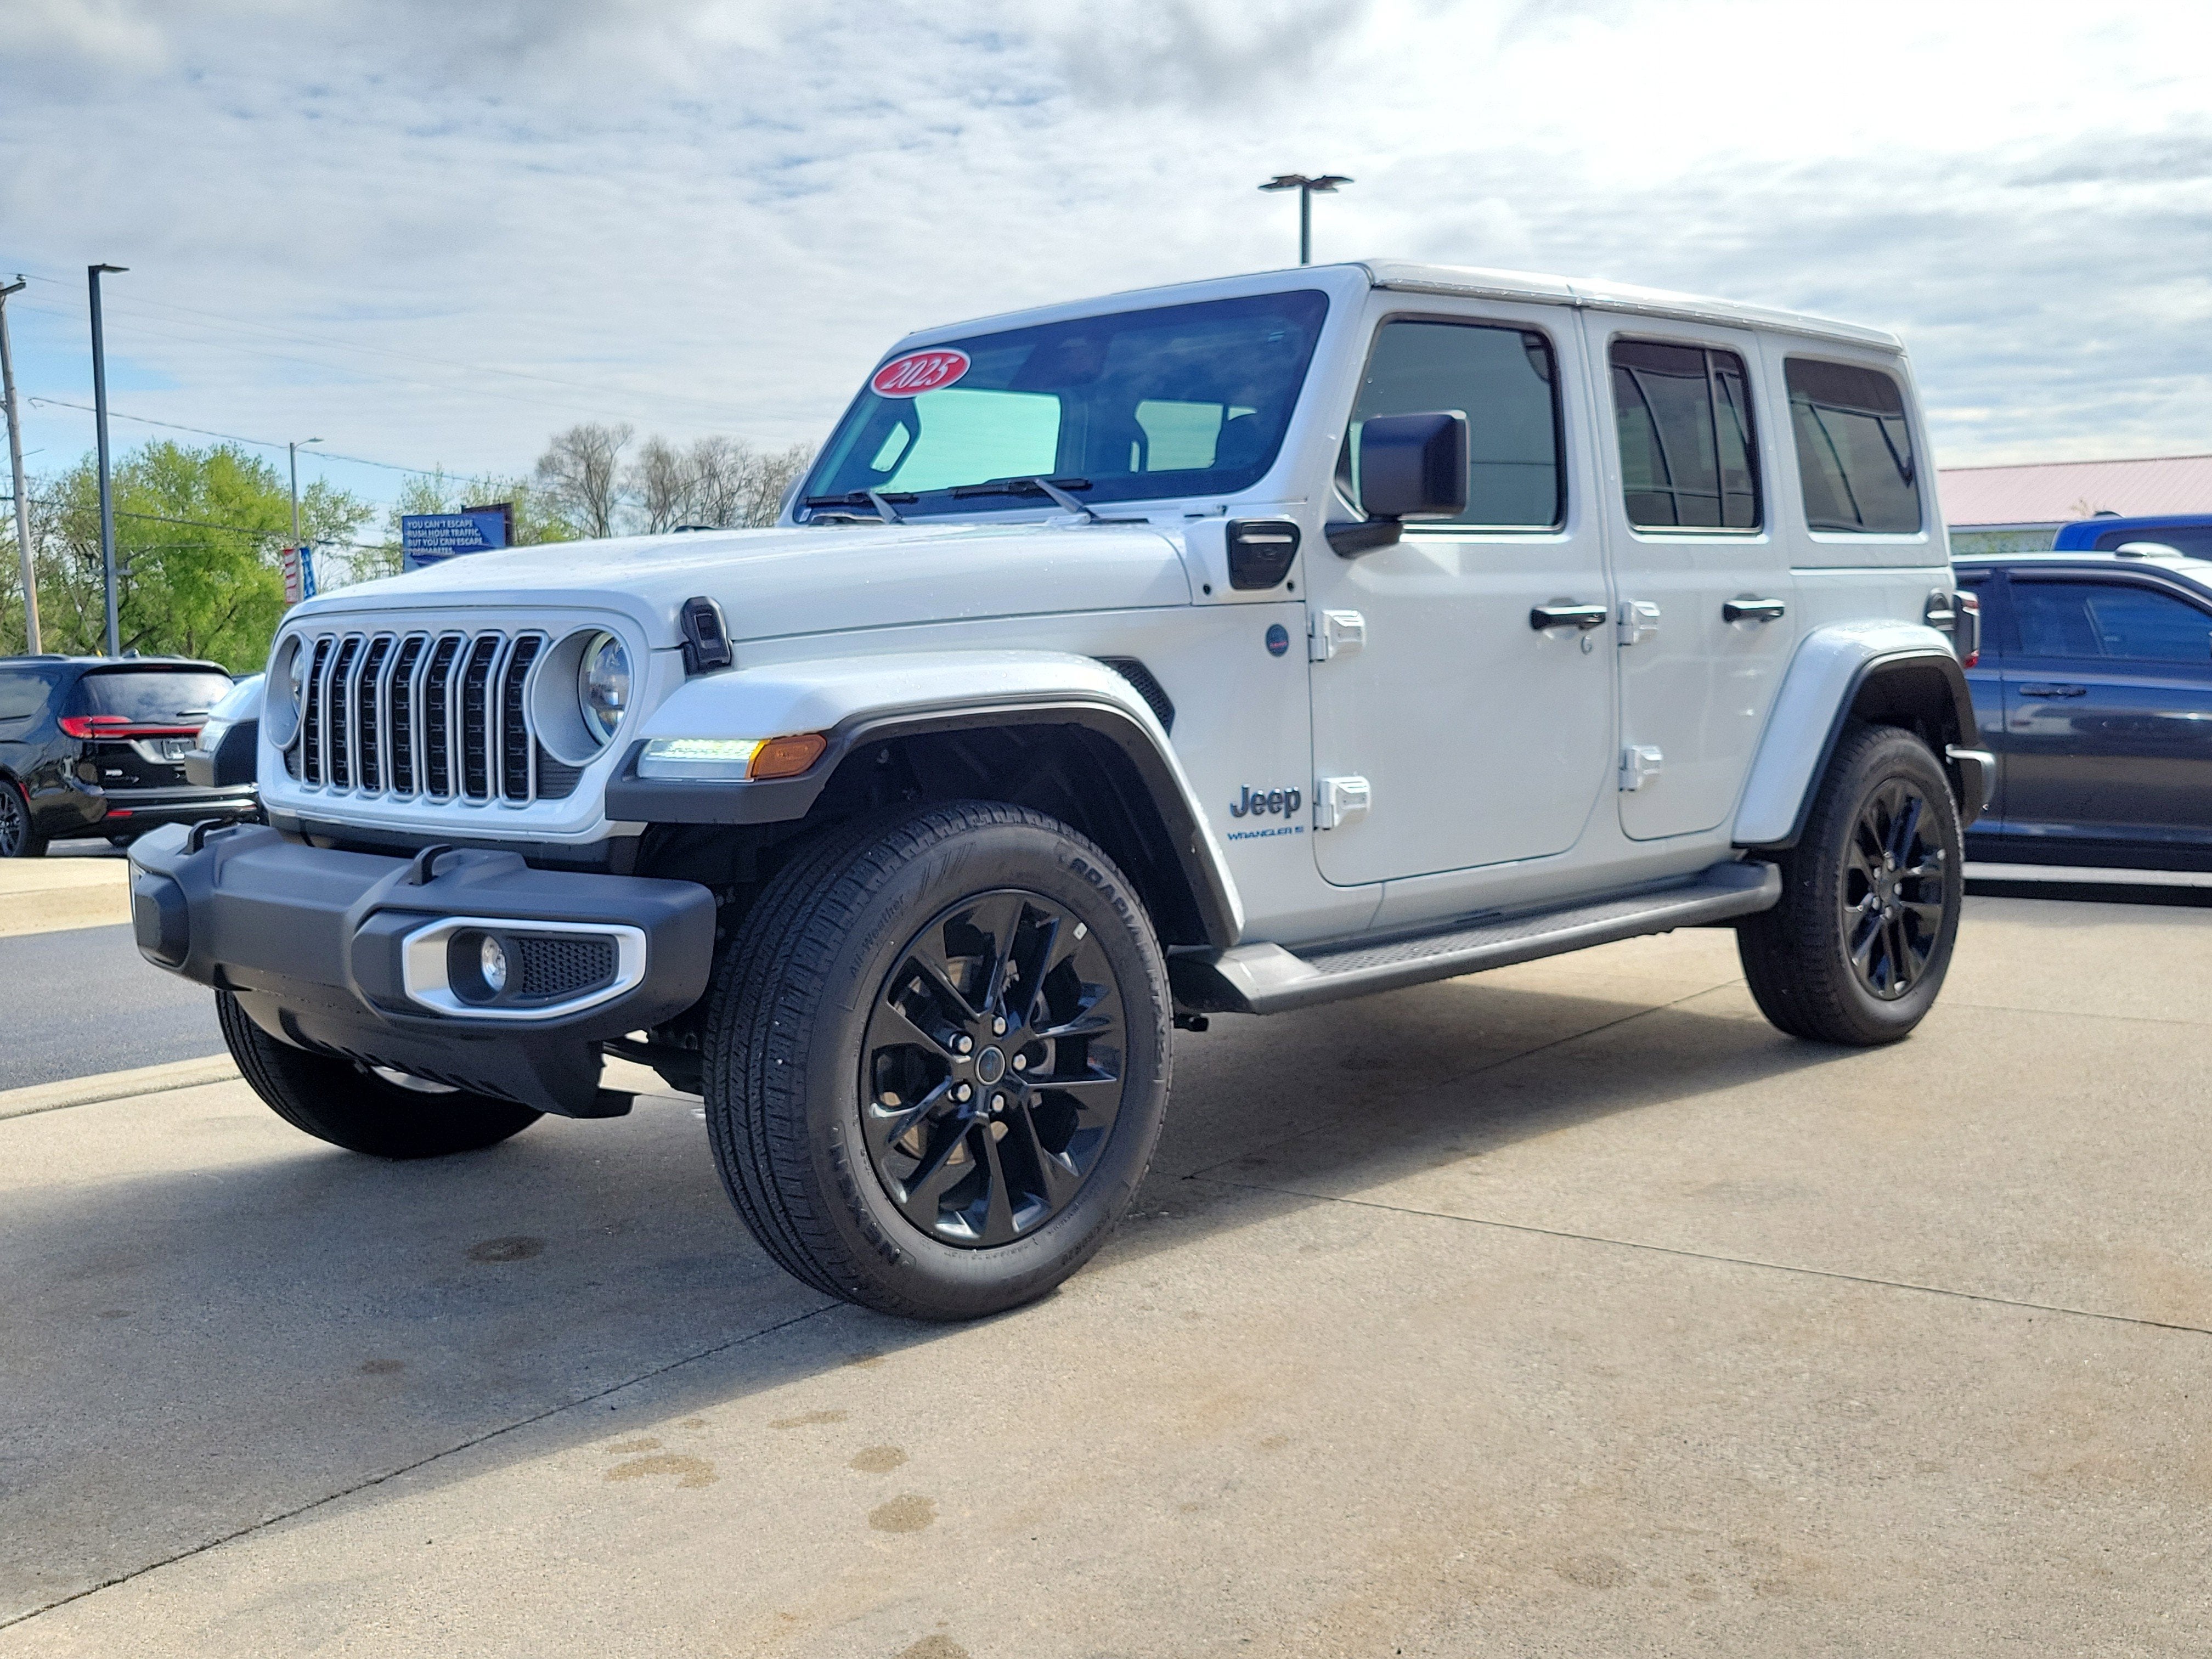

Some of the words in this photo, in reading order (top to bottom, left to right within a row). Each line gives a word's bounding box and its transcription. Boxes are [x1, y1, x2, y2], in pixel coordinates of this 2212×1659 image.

[880, 357, 960, 390] 2025
[448, 519, 473, 527] ESCAPE
[408, 529, 427, 537] RUSH
[428, 528, 450, 537] HOUR
[408, 539, 421, 547] BUT
[422, 538, 438, 546] YOU
[456, 537, 483, 545] ESCAPE
[1230, 784, 1301, 819] Jeep
[1227, 827, 1292, 840] WRANGLER
[850, 894, 904, 978] All-Weather
